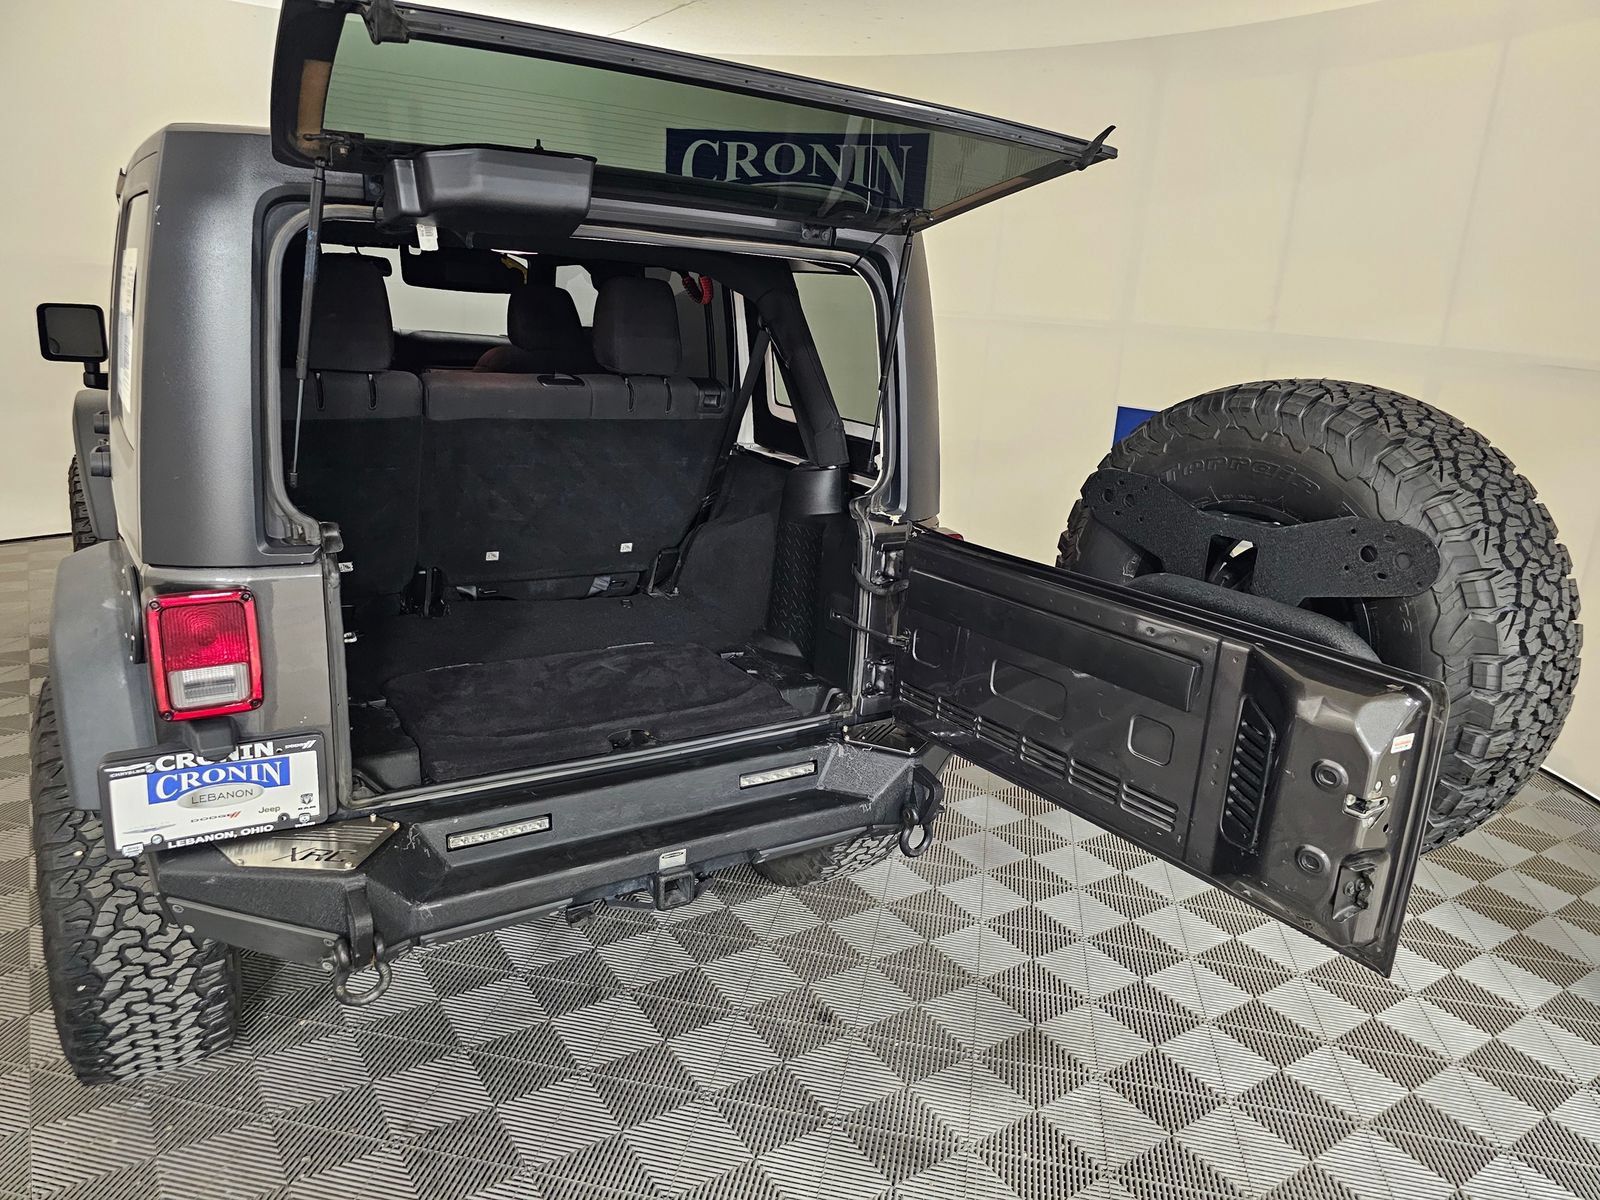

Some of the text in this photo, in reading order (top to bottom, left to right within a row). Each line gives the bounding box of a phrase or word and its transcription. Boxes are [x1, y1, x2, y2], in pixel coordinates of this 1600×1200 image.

[681, 139, 912, 205] CRONIN
[155, 760, 283, 800] CRONIN
[190, 788, 254, 805] LEBANON
[258, 805, 281, 814] Jeep
[167, 823, 275, 849] LEBANON, OHIO
